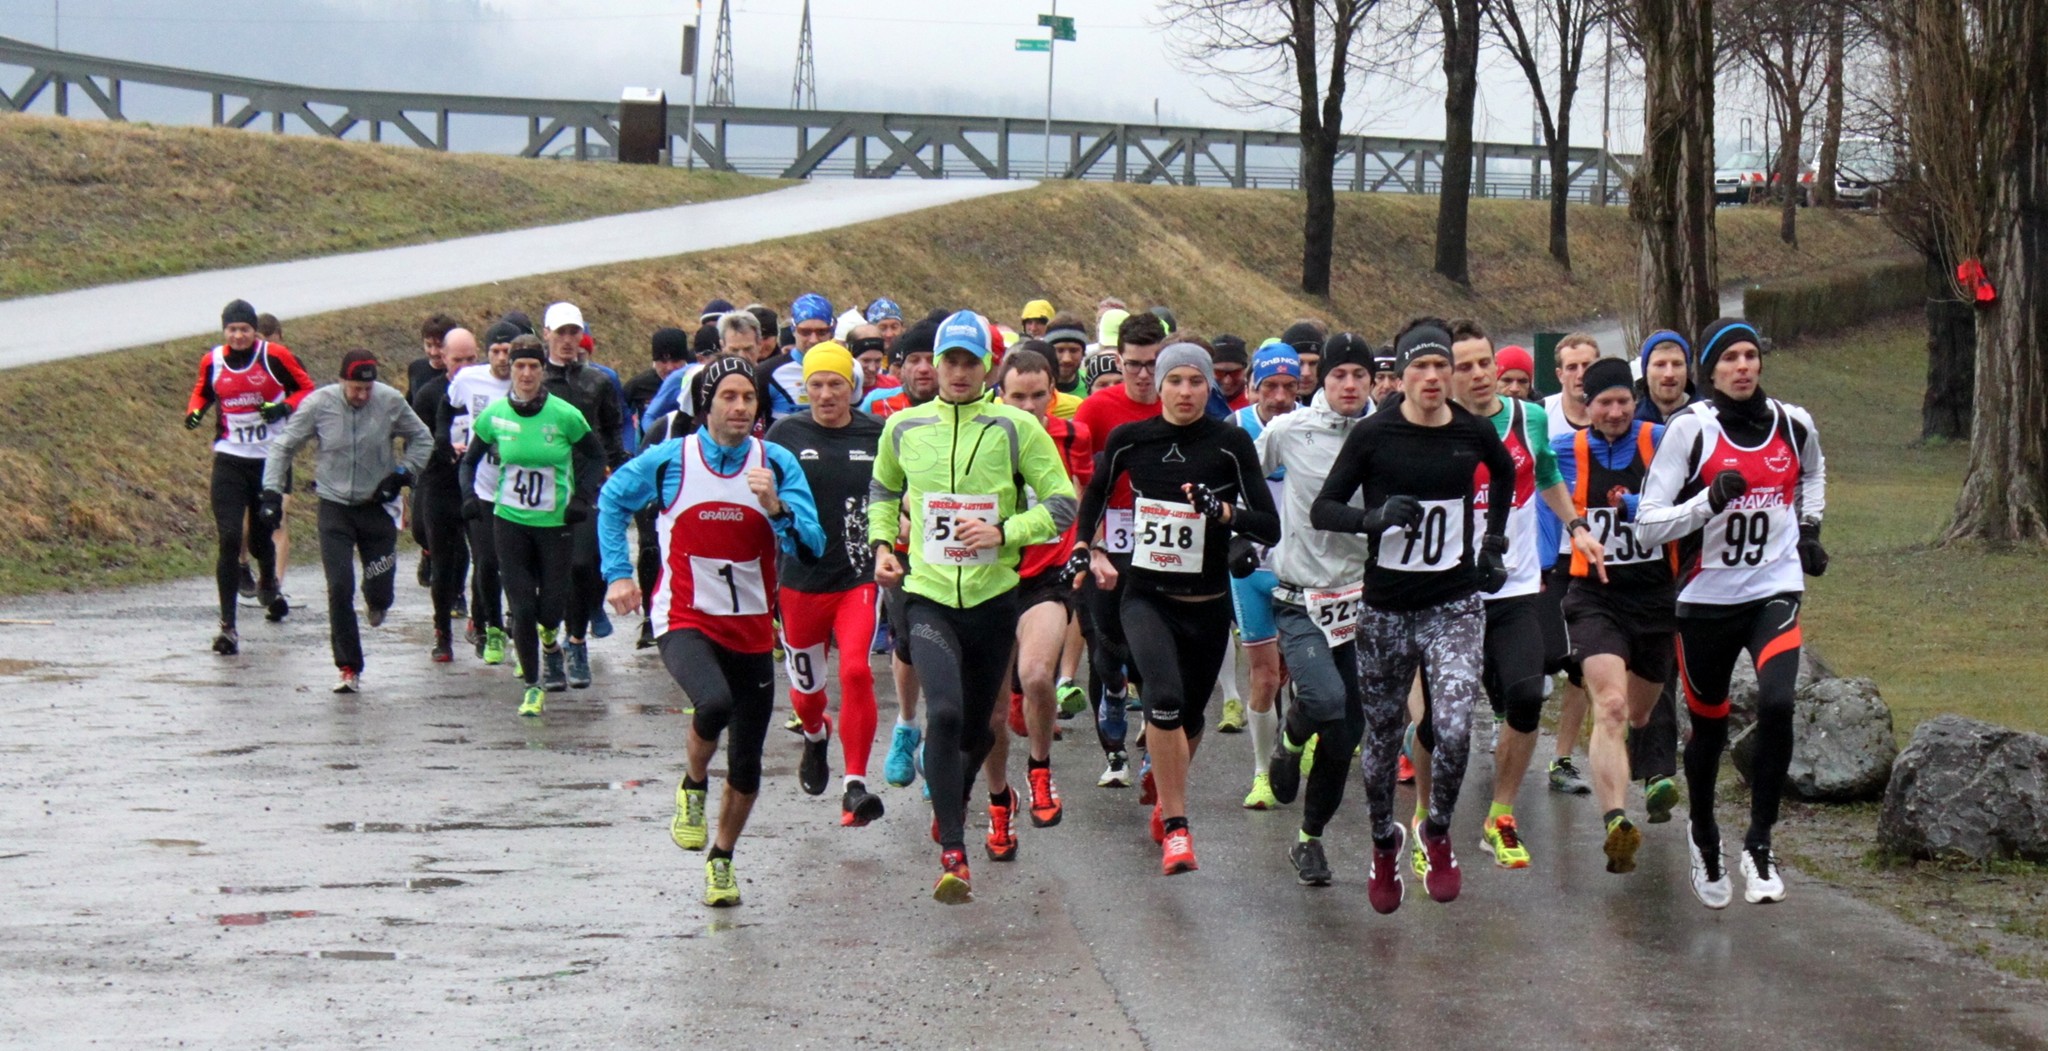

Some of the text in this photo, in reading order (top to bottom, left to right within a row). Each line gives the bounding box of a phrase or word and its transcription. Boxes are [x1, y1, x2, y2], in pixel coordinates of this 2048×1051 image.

[234, 423, 267, 443] 170
[513, 469, 543, 507] 40
[698, 510, 744, 521] GRAVAG
[1143, 521, 1193, 550] 518
[1721, 511, 1769, 567] 99
[718, 563, 740, 613] 1
